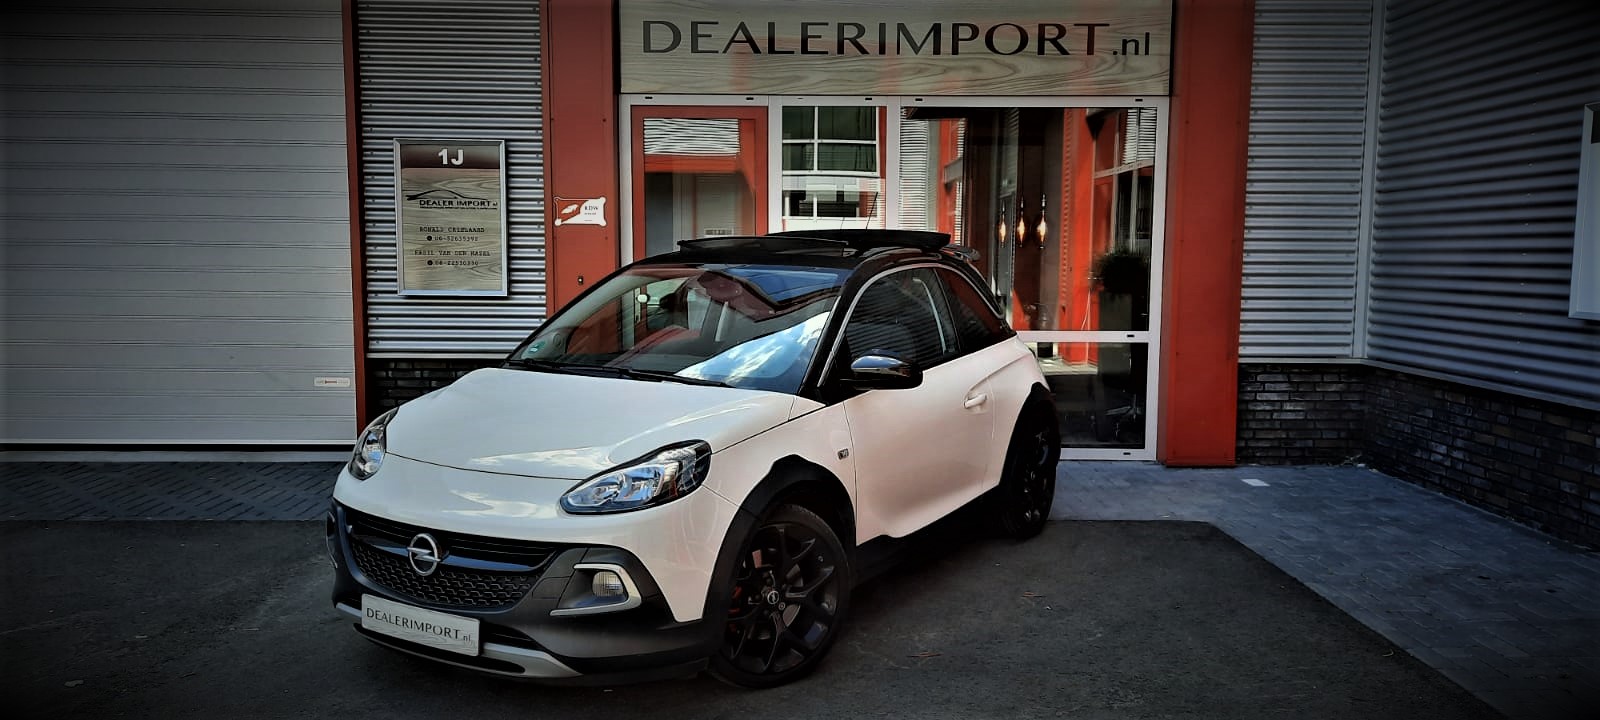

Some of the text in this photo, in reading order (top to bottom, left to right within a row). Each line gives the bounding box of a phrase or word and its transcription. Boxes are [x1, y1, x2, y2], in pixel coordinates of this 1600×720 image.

[642, 20, 1151, 57] DEALERIMPORT.nl
[438, 148, 464, 166] 1J
[419, 199, 454, 207] DEALER
